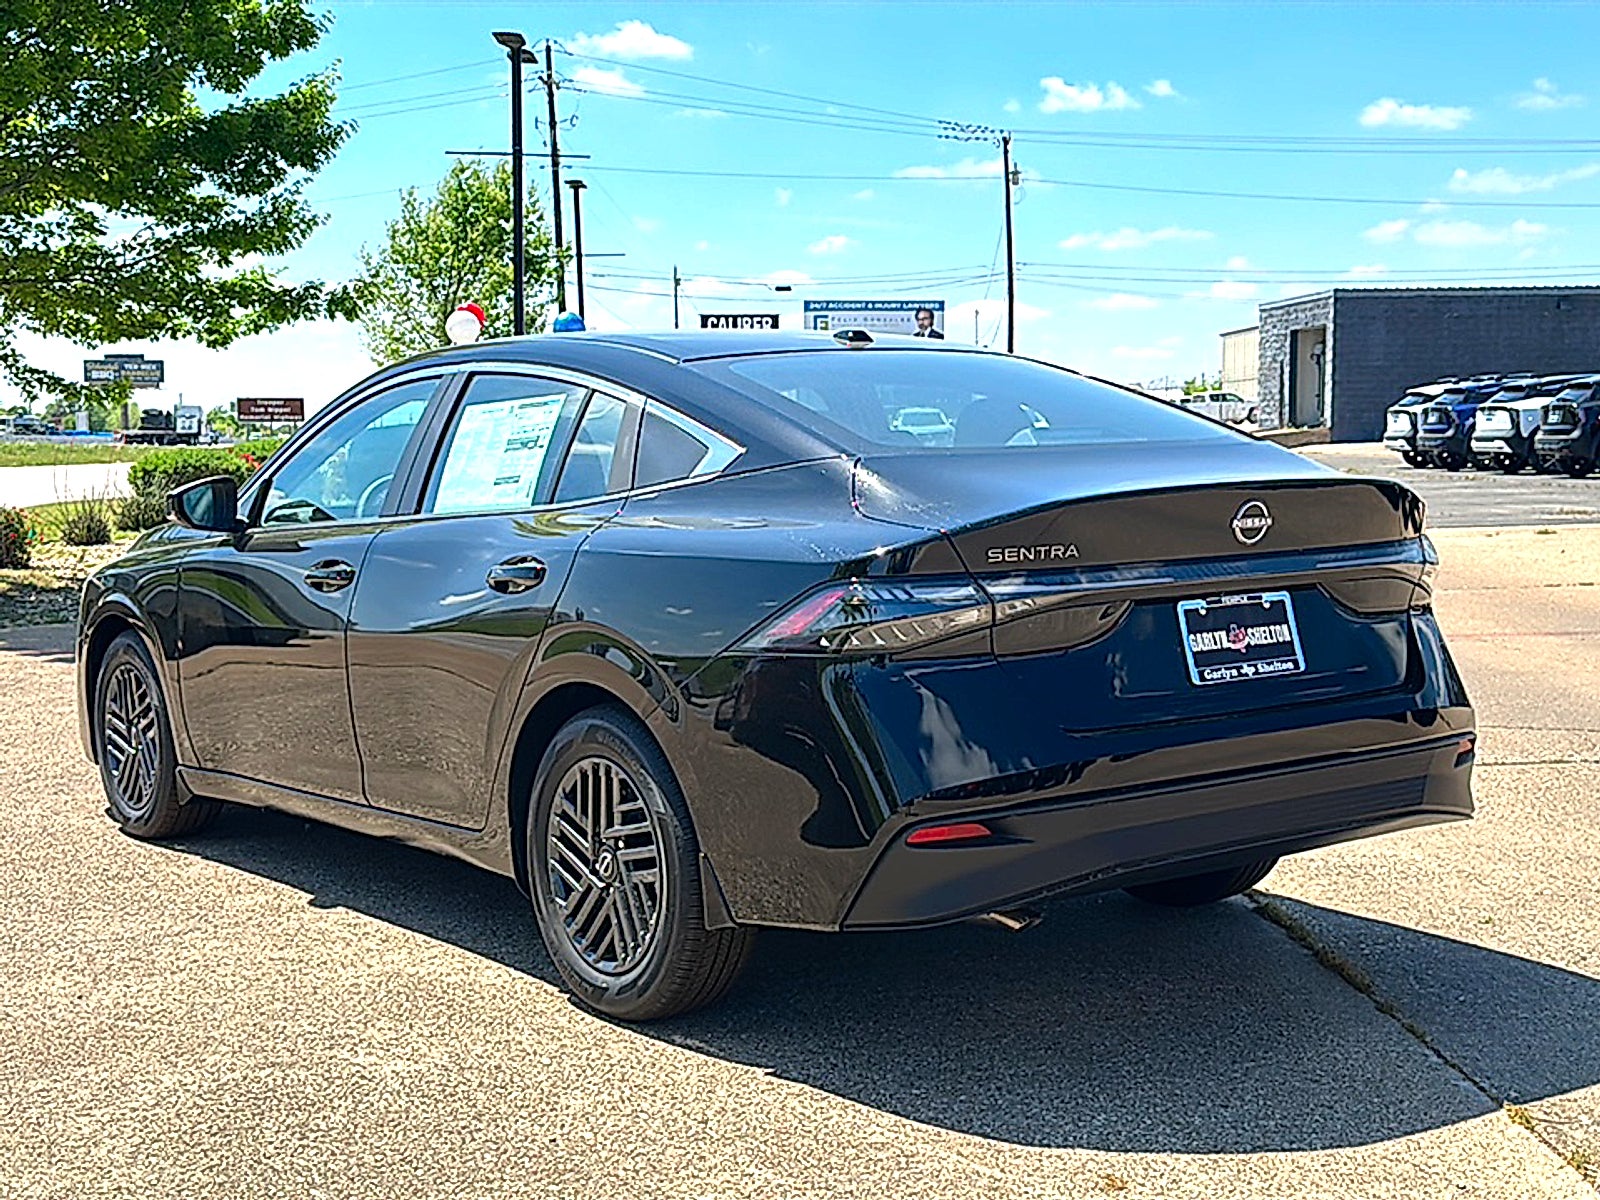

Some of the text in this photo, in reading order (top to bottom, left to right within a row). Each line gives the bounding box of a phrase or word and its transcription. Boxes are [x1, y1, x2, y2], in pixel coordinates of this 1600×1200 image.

[1232, 515, 1273, 529] NISSAN
[987, 544, 1079, 564] SENTRA
[1189, 623, 1291, 652] GARLYN SHELTON
[1204, 660, 1294, 680] Garlyn Shelton
